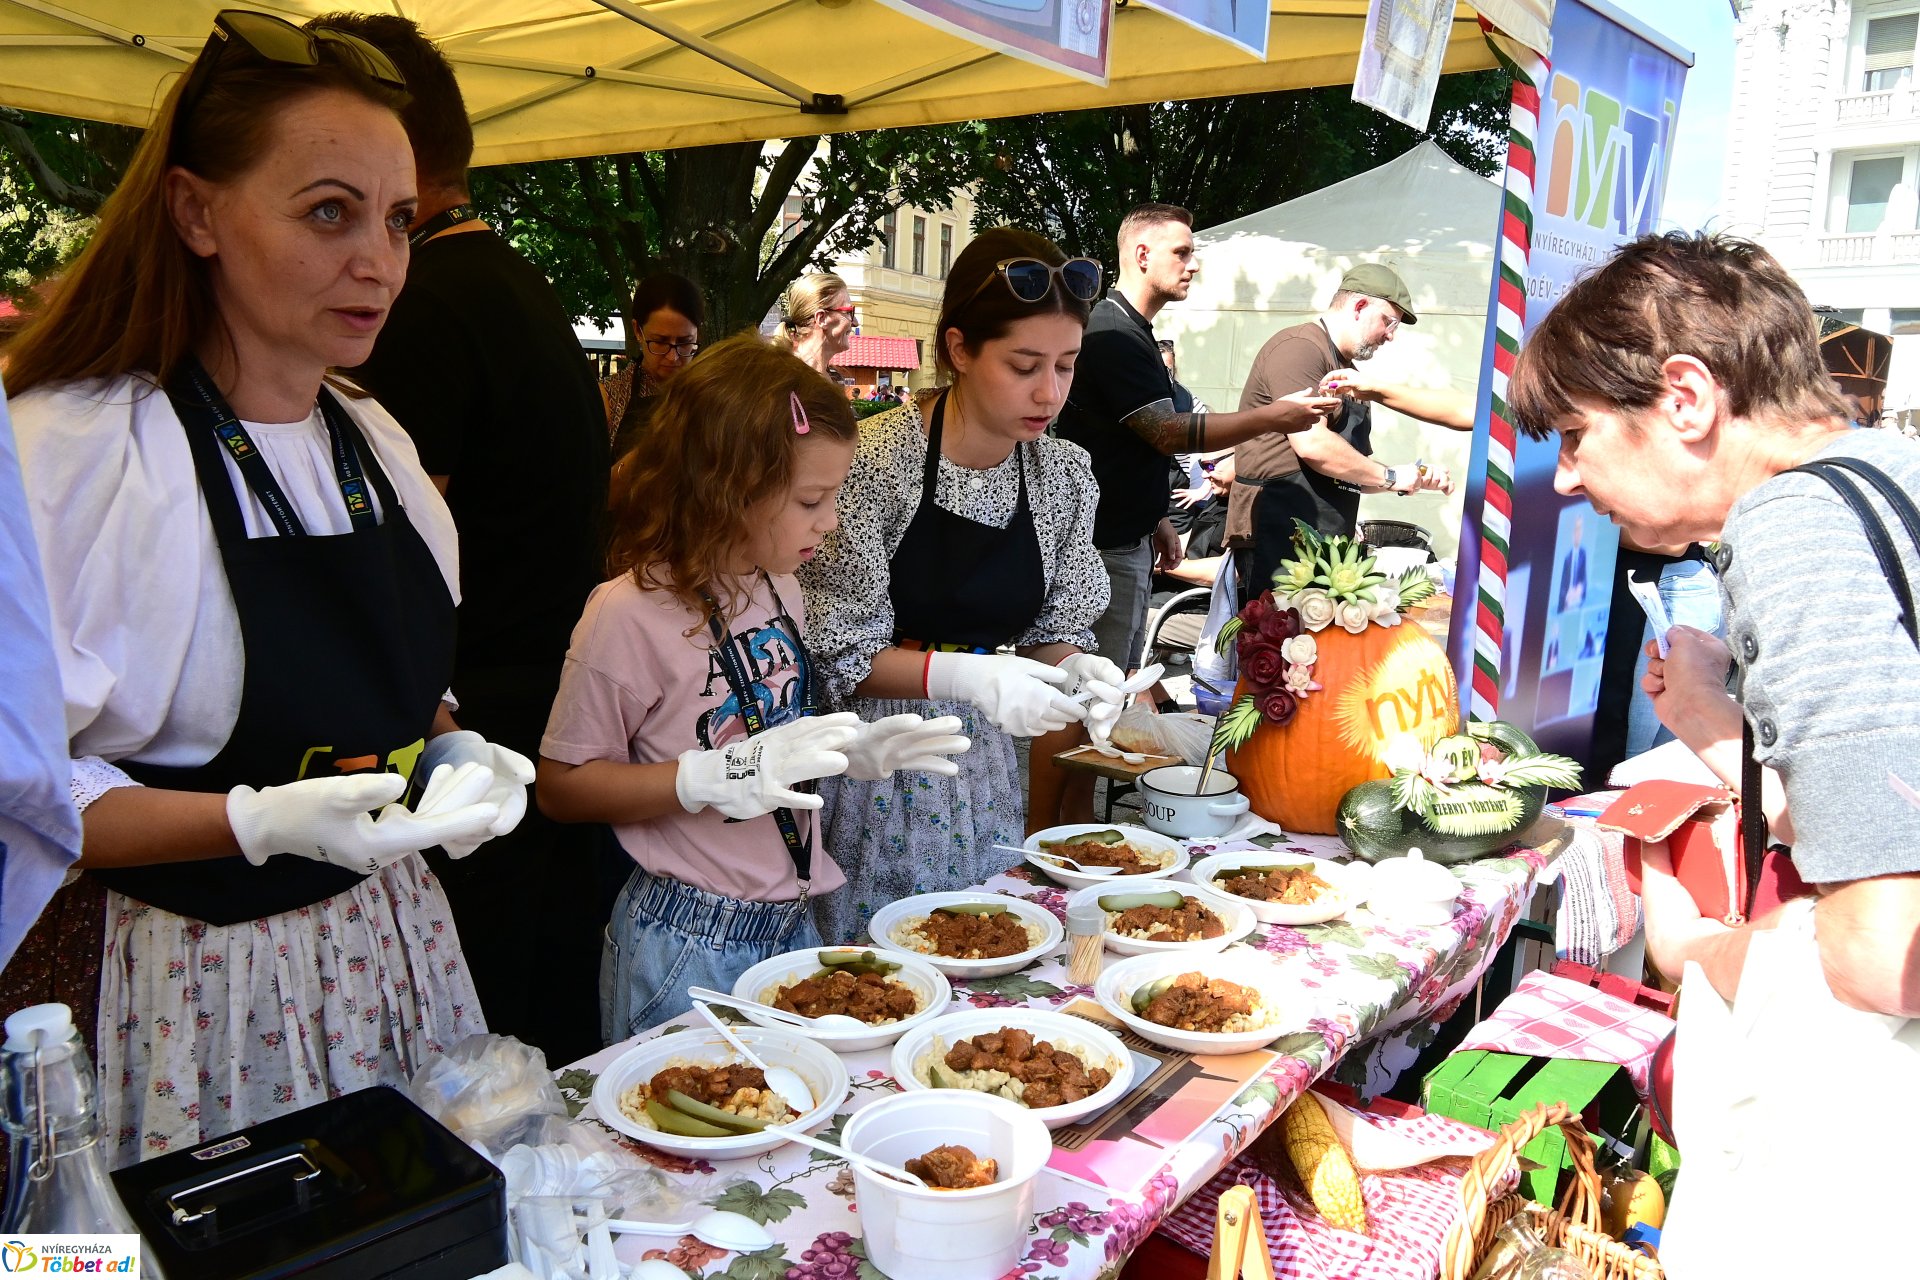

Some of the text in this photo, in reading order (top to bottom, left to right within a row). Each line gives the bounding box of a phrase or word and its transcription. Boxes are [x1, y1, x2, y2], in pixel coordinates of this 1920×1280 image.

[1534, 231, 1597, 262] NYÍREGYHÁZI
[1539, 276, 1553, 299] ÉV
[1462, 747, 1474, 767] ÉV
[1143, 798, 1176, 822] SOUP
[1431, 803, 1467, 816] EZERNYI
